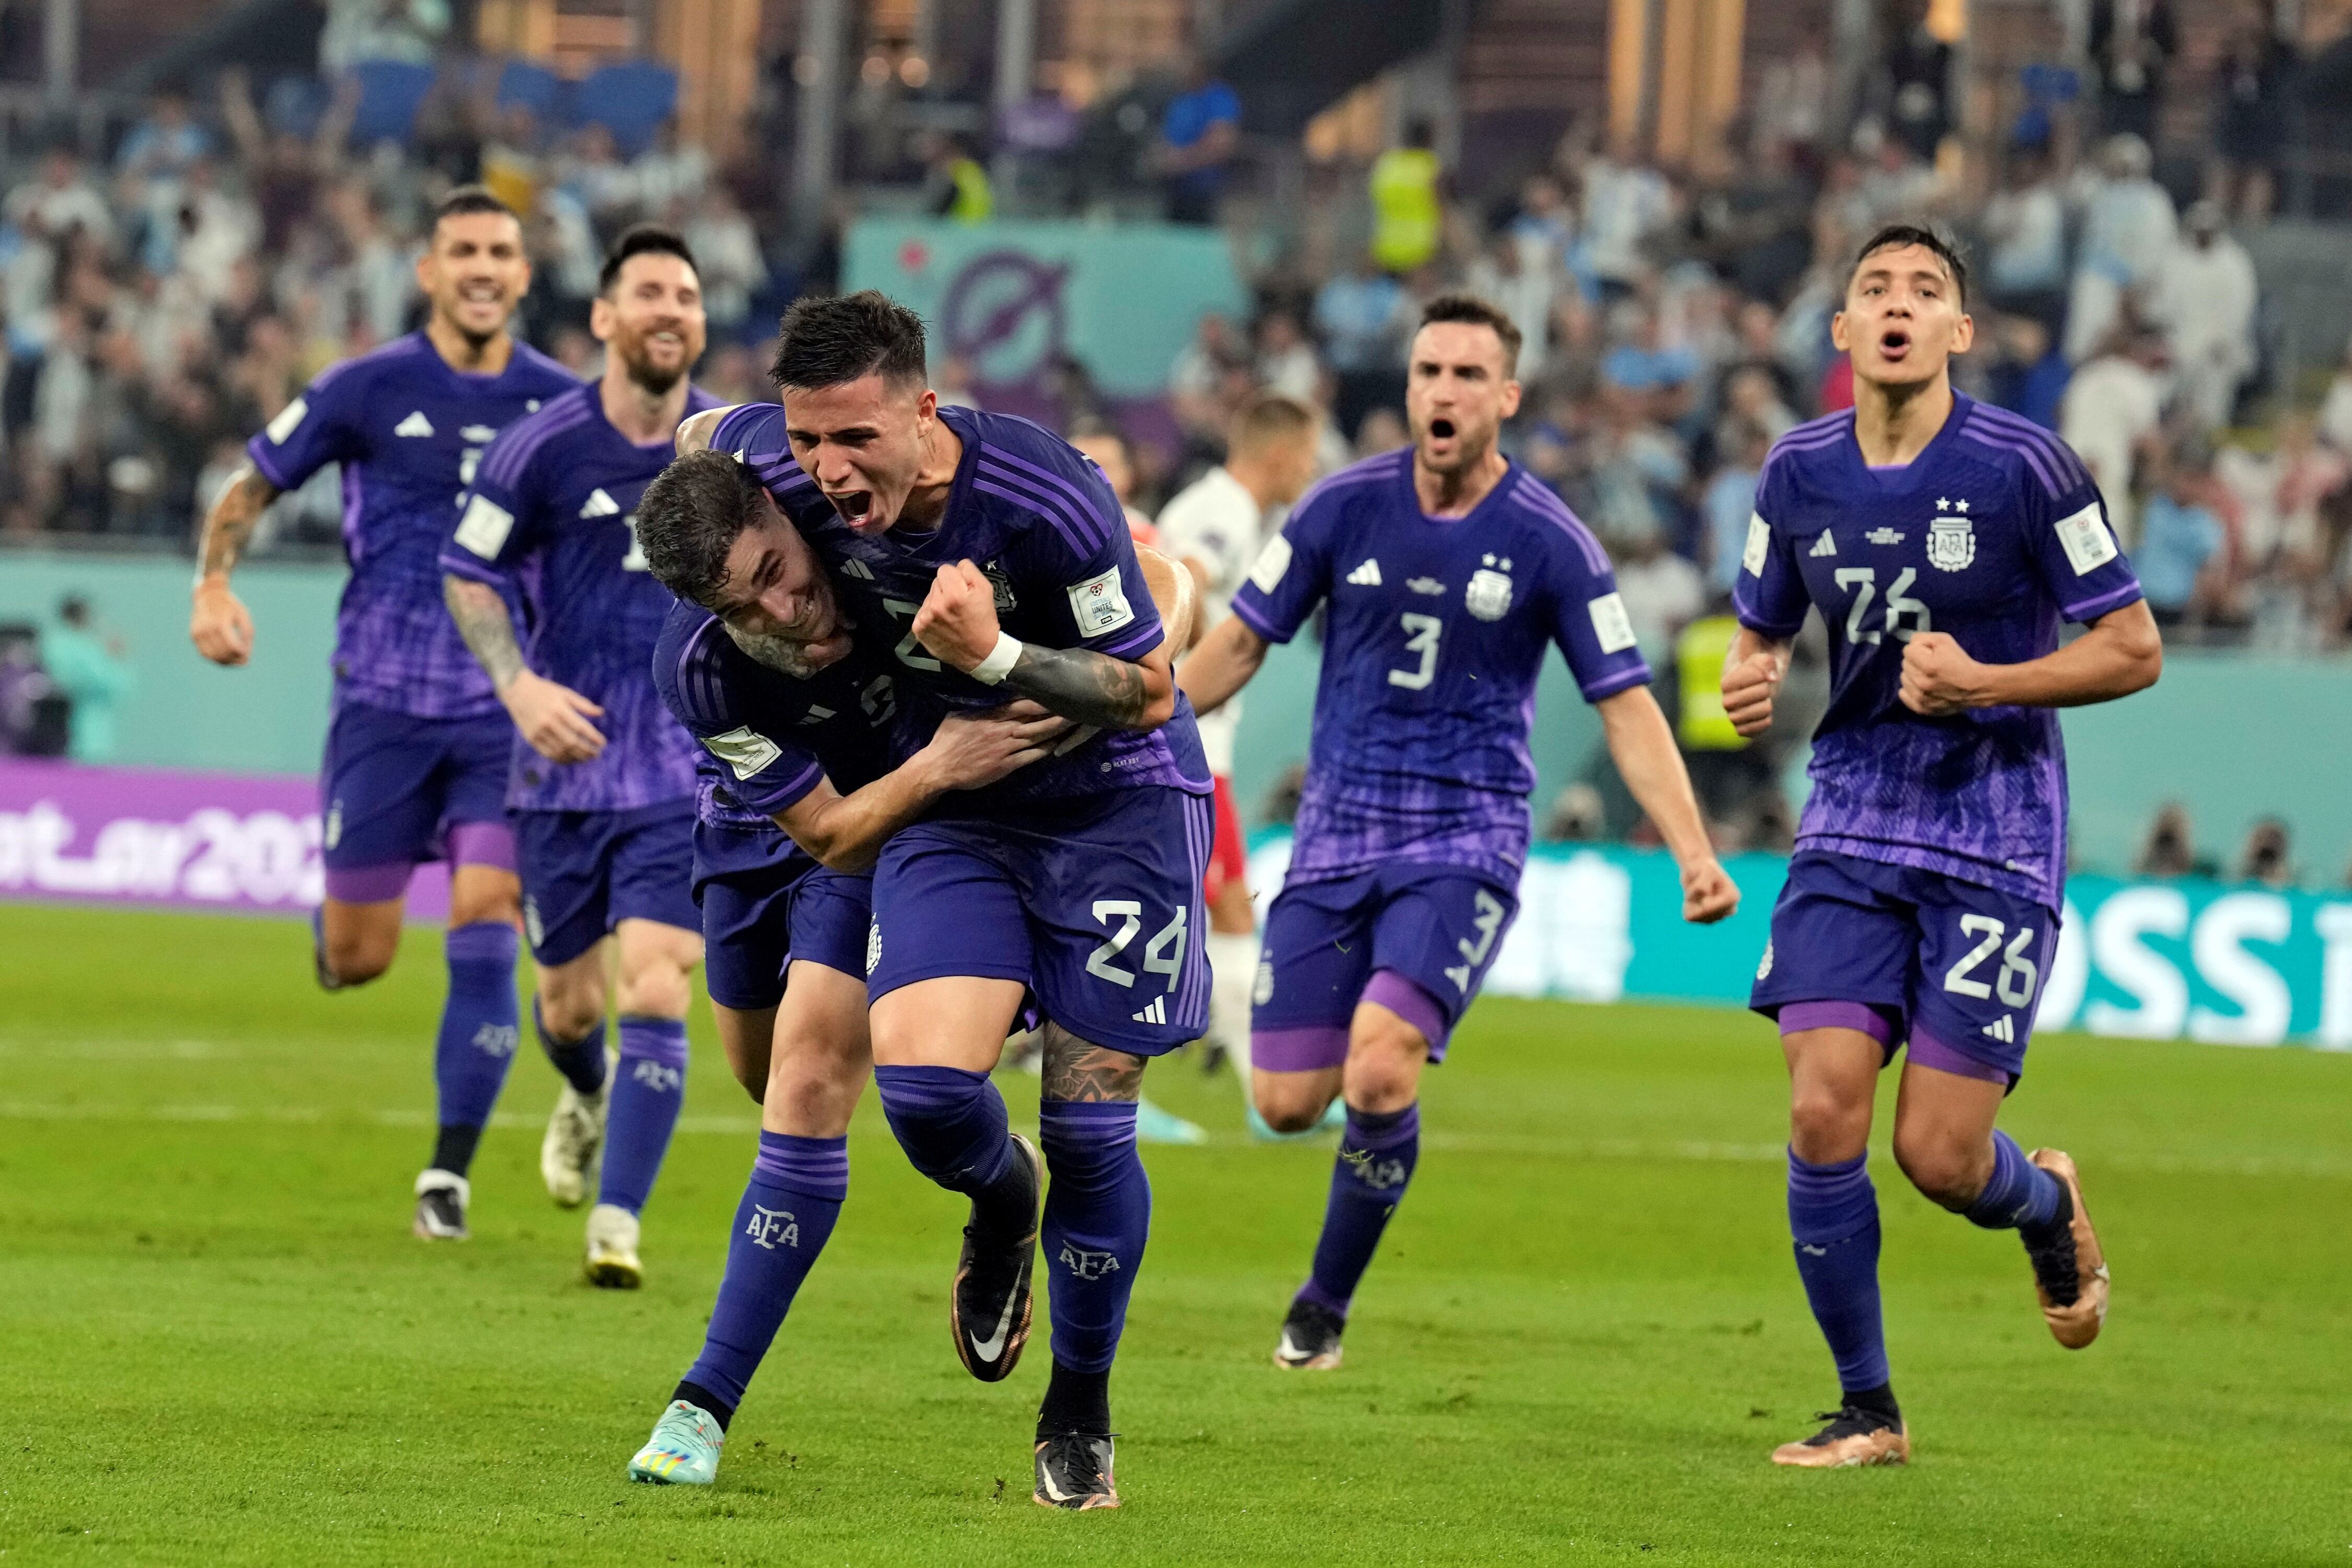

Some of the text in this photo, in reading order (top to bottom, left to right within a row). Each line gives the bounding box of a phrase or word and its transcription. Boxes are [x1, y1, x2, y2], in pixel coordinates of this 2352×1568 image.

[1092, 601, 1113, 614] UNITES
[1835, 567, 1931, 645] 26
[1388, 612, 1443, 690] 3
[1085, 900, 1187, 993] 24
[1458, 889, 1505, 966] 3
[1944, 913, 2037, 1009] 26
[745, 1203, 799, 1249] AFA
[1059, 1239, 1120, 1281] AFA
